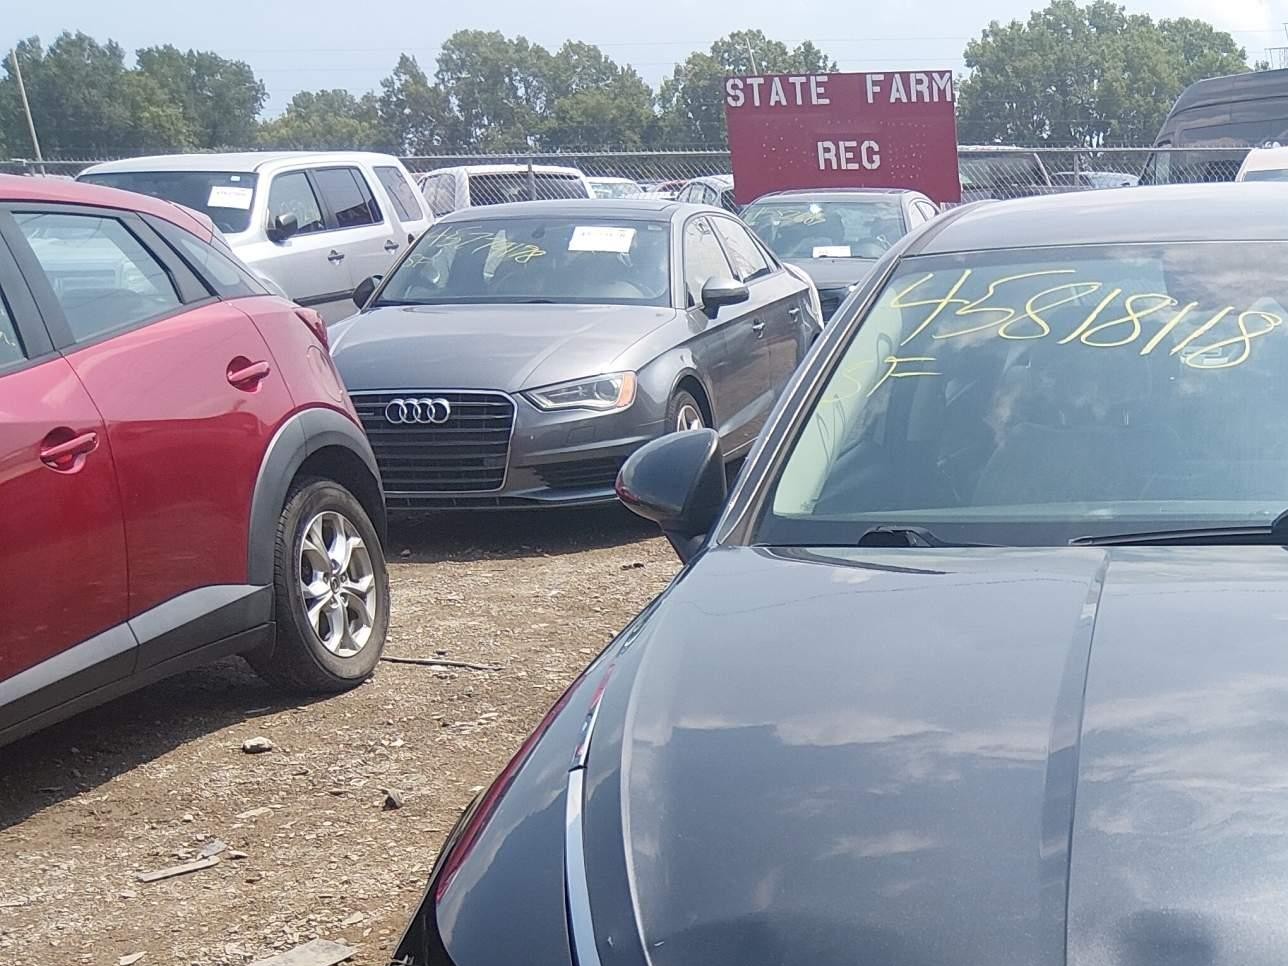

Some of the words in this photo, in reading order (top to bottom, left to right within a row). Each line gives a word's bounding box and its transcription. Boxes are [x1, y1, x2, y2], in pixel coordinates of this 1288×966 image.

[725, 74, 831, 108] STATE
[865, 72, 953, 104] FARM
[816, 140, 881, 170] REG
[890, 269, 1283, 369] 45818118
